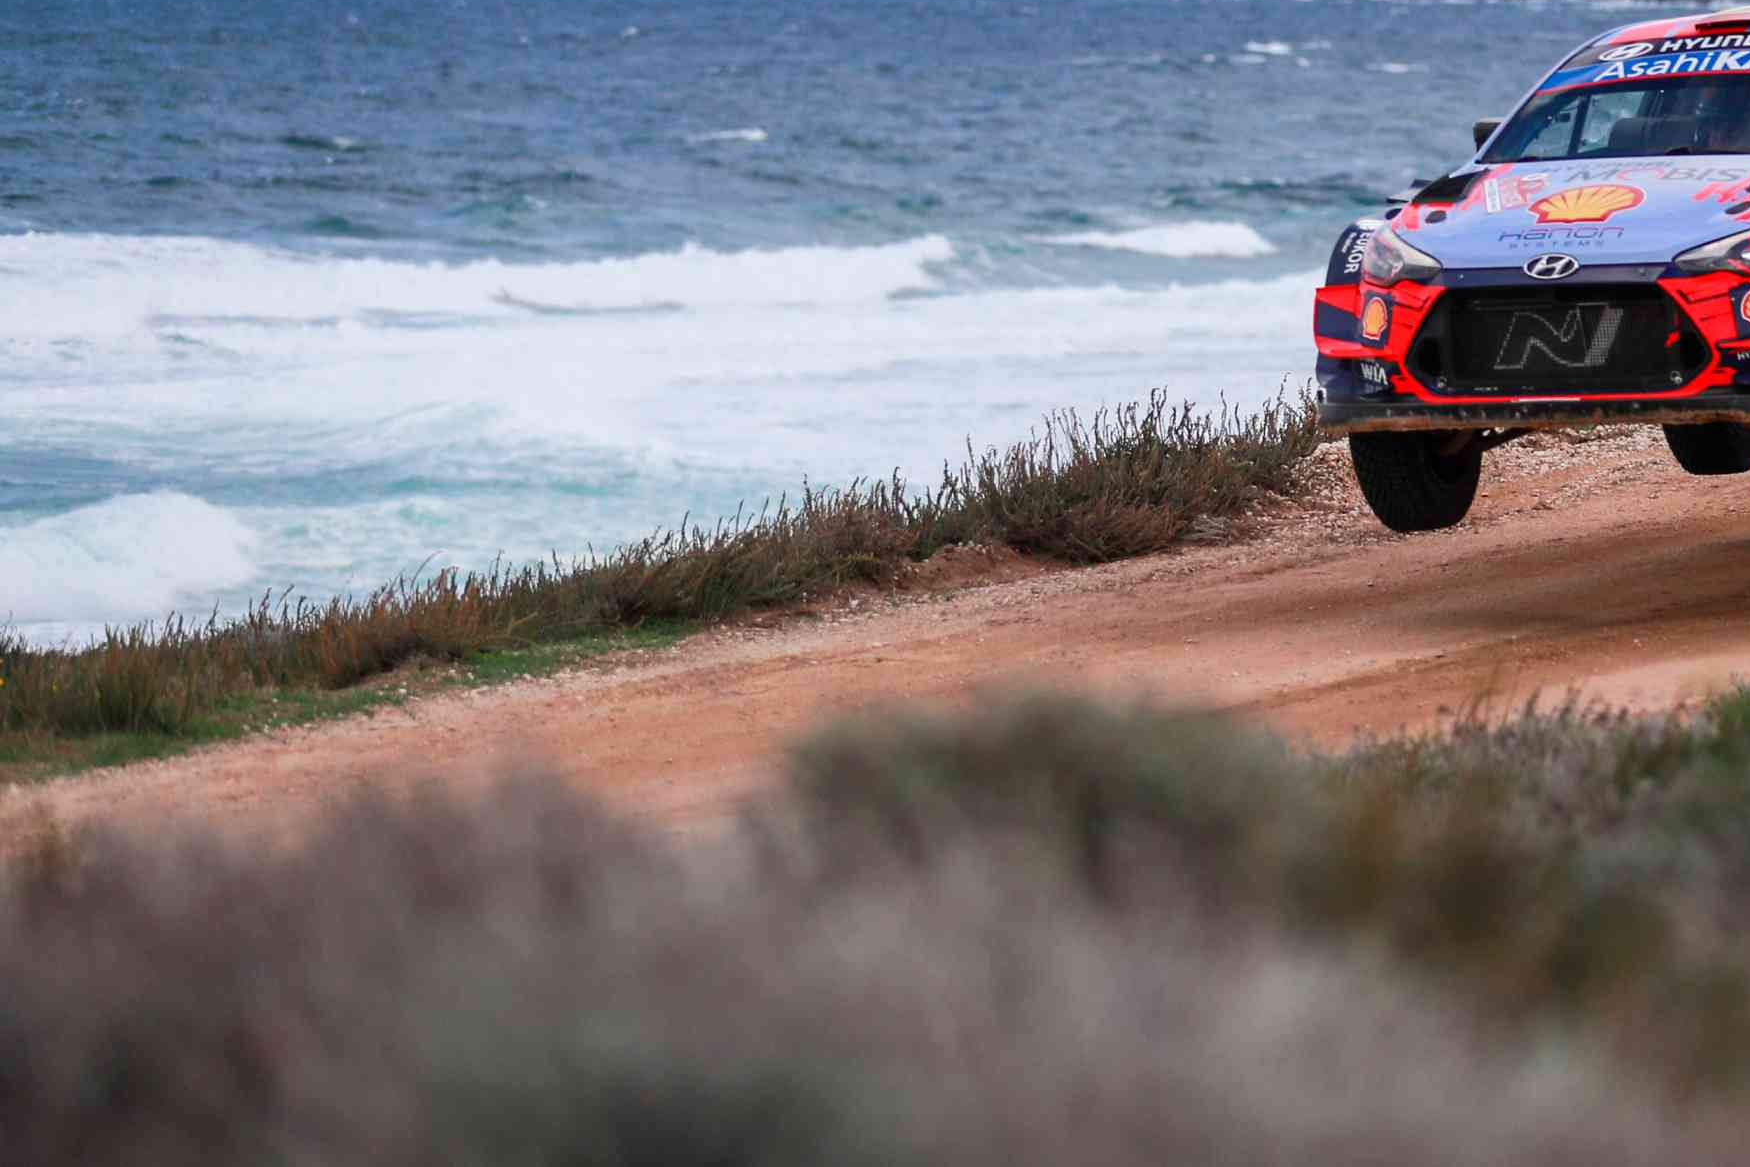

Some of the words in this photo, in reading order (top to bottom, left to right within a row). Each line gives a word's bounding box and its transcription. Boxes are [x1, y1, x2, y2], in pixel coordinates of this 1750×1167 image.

[1564, 167, 1749, 183] MOBIS
[1508, 240, 1605, 248] SYSTEMS
[1493, 302, 1624, 370] N
